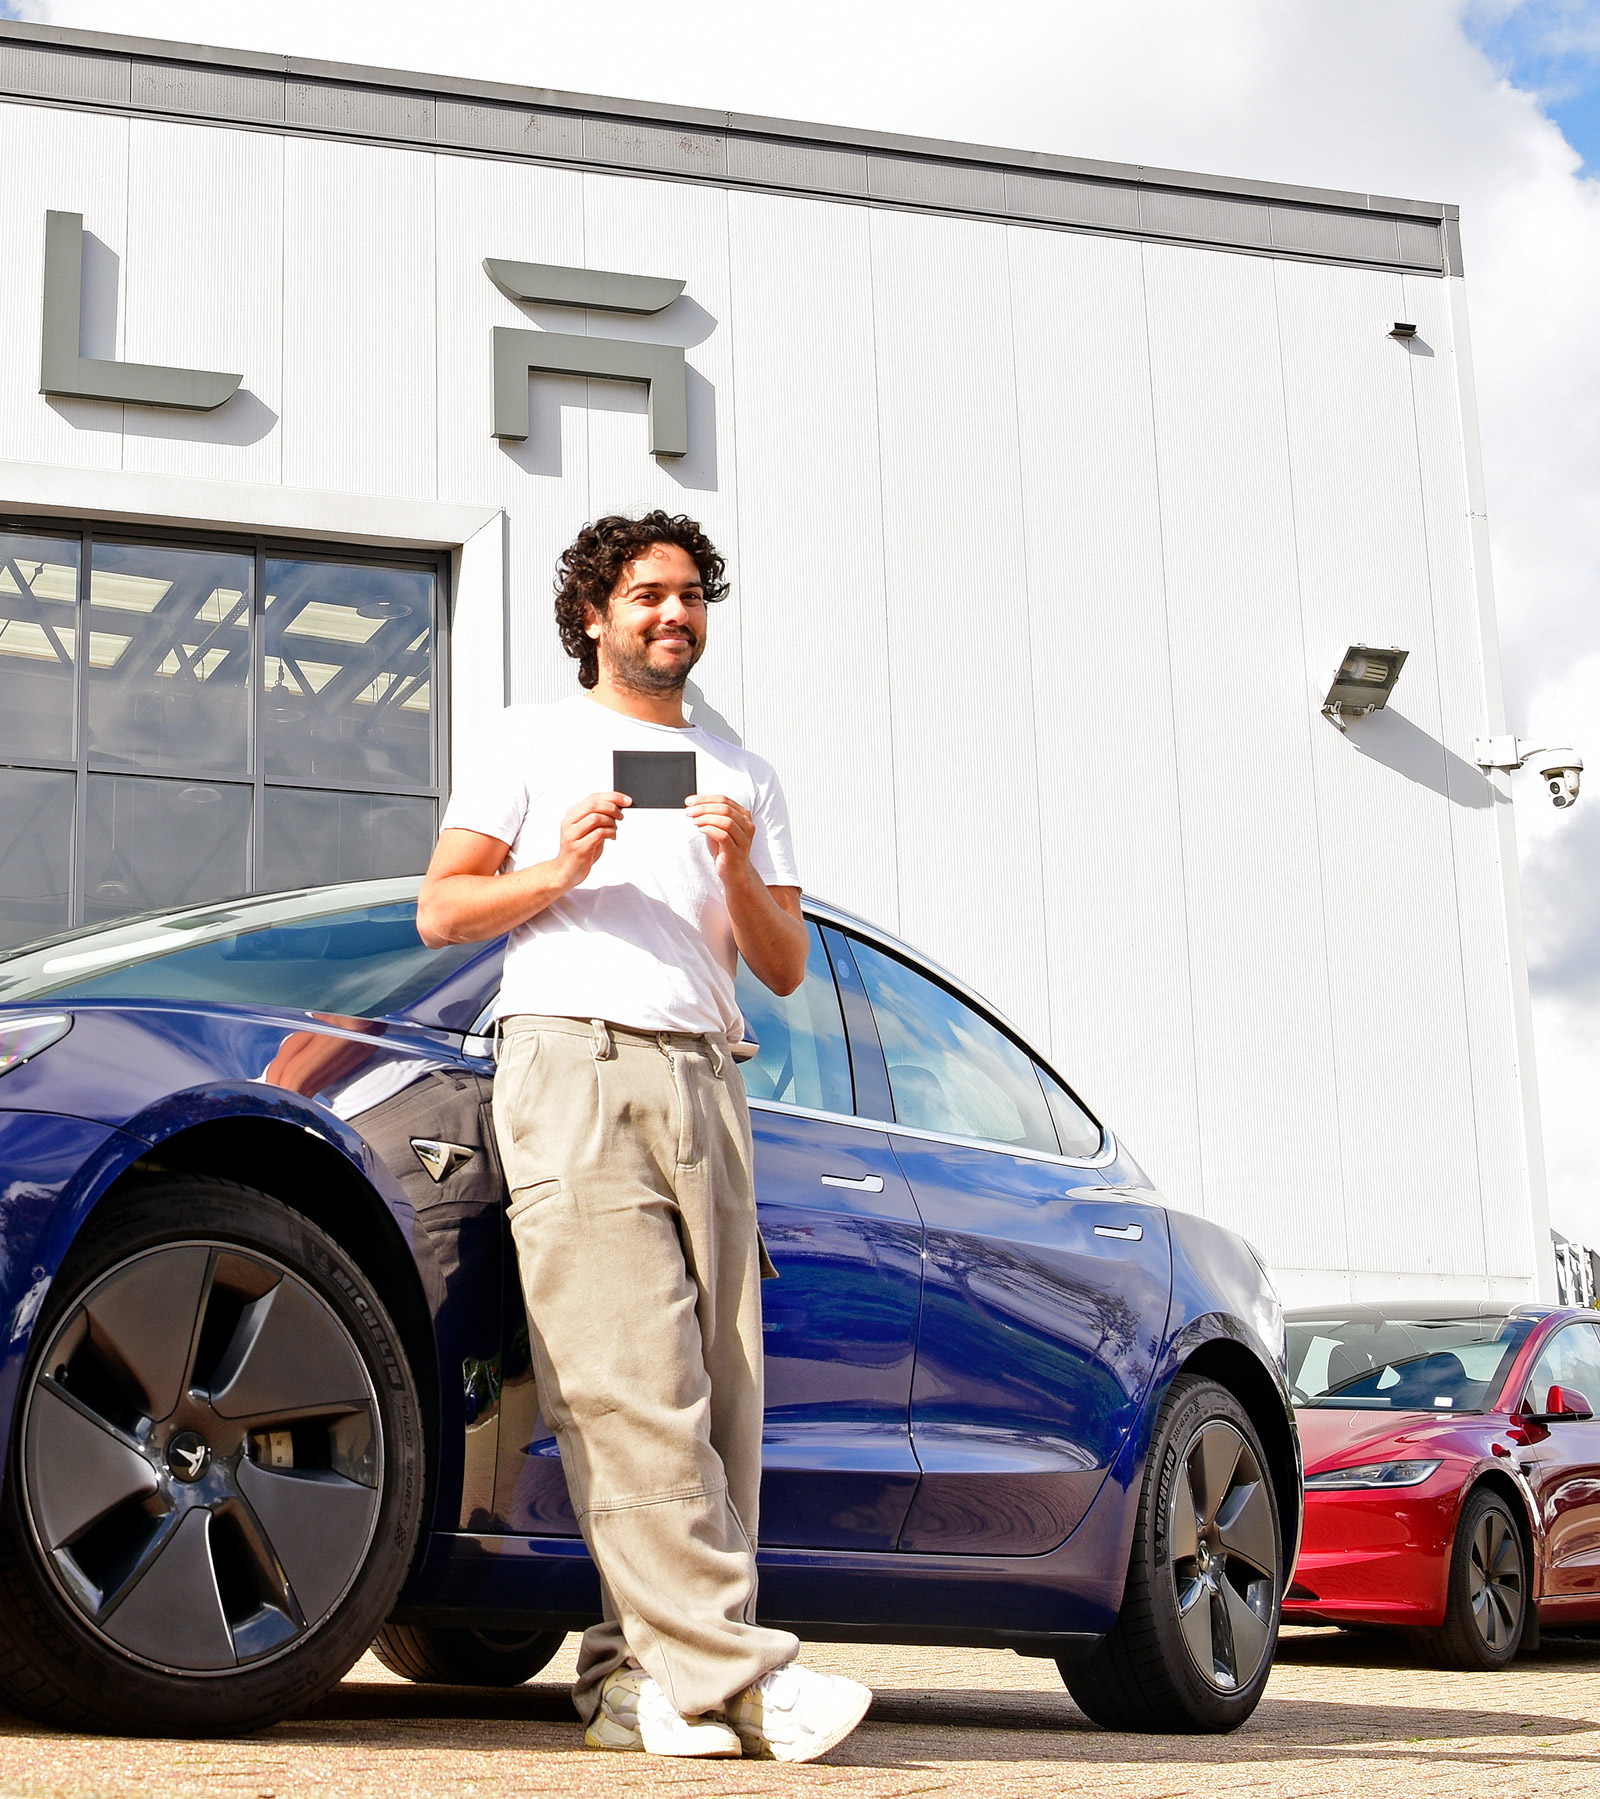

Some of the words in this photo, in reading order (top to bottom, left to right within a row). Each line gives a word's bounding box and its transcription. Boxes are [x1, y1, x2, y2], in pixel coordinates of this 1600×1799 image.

[331, 1268, 403, 1385] MICHELIN
[402, 1405, 413, 1448] PILOT
[404, 1457, 414, 1511] SPORT
[1156, 1448, 1176, 1536] MICHELIN
